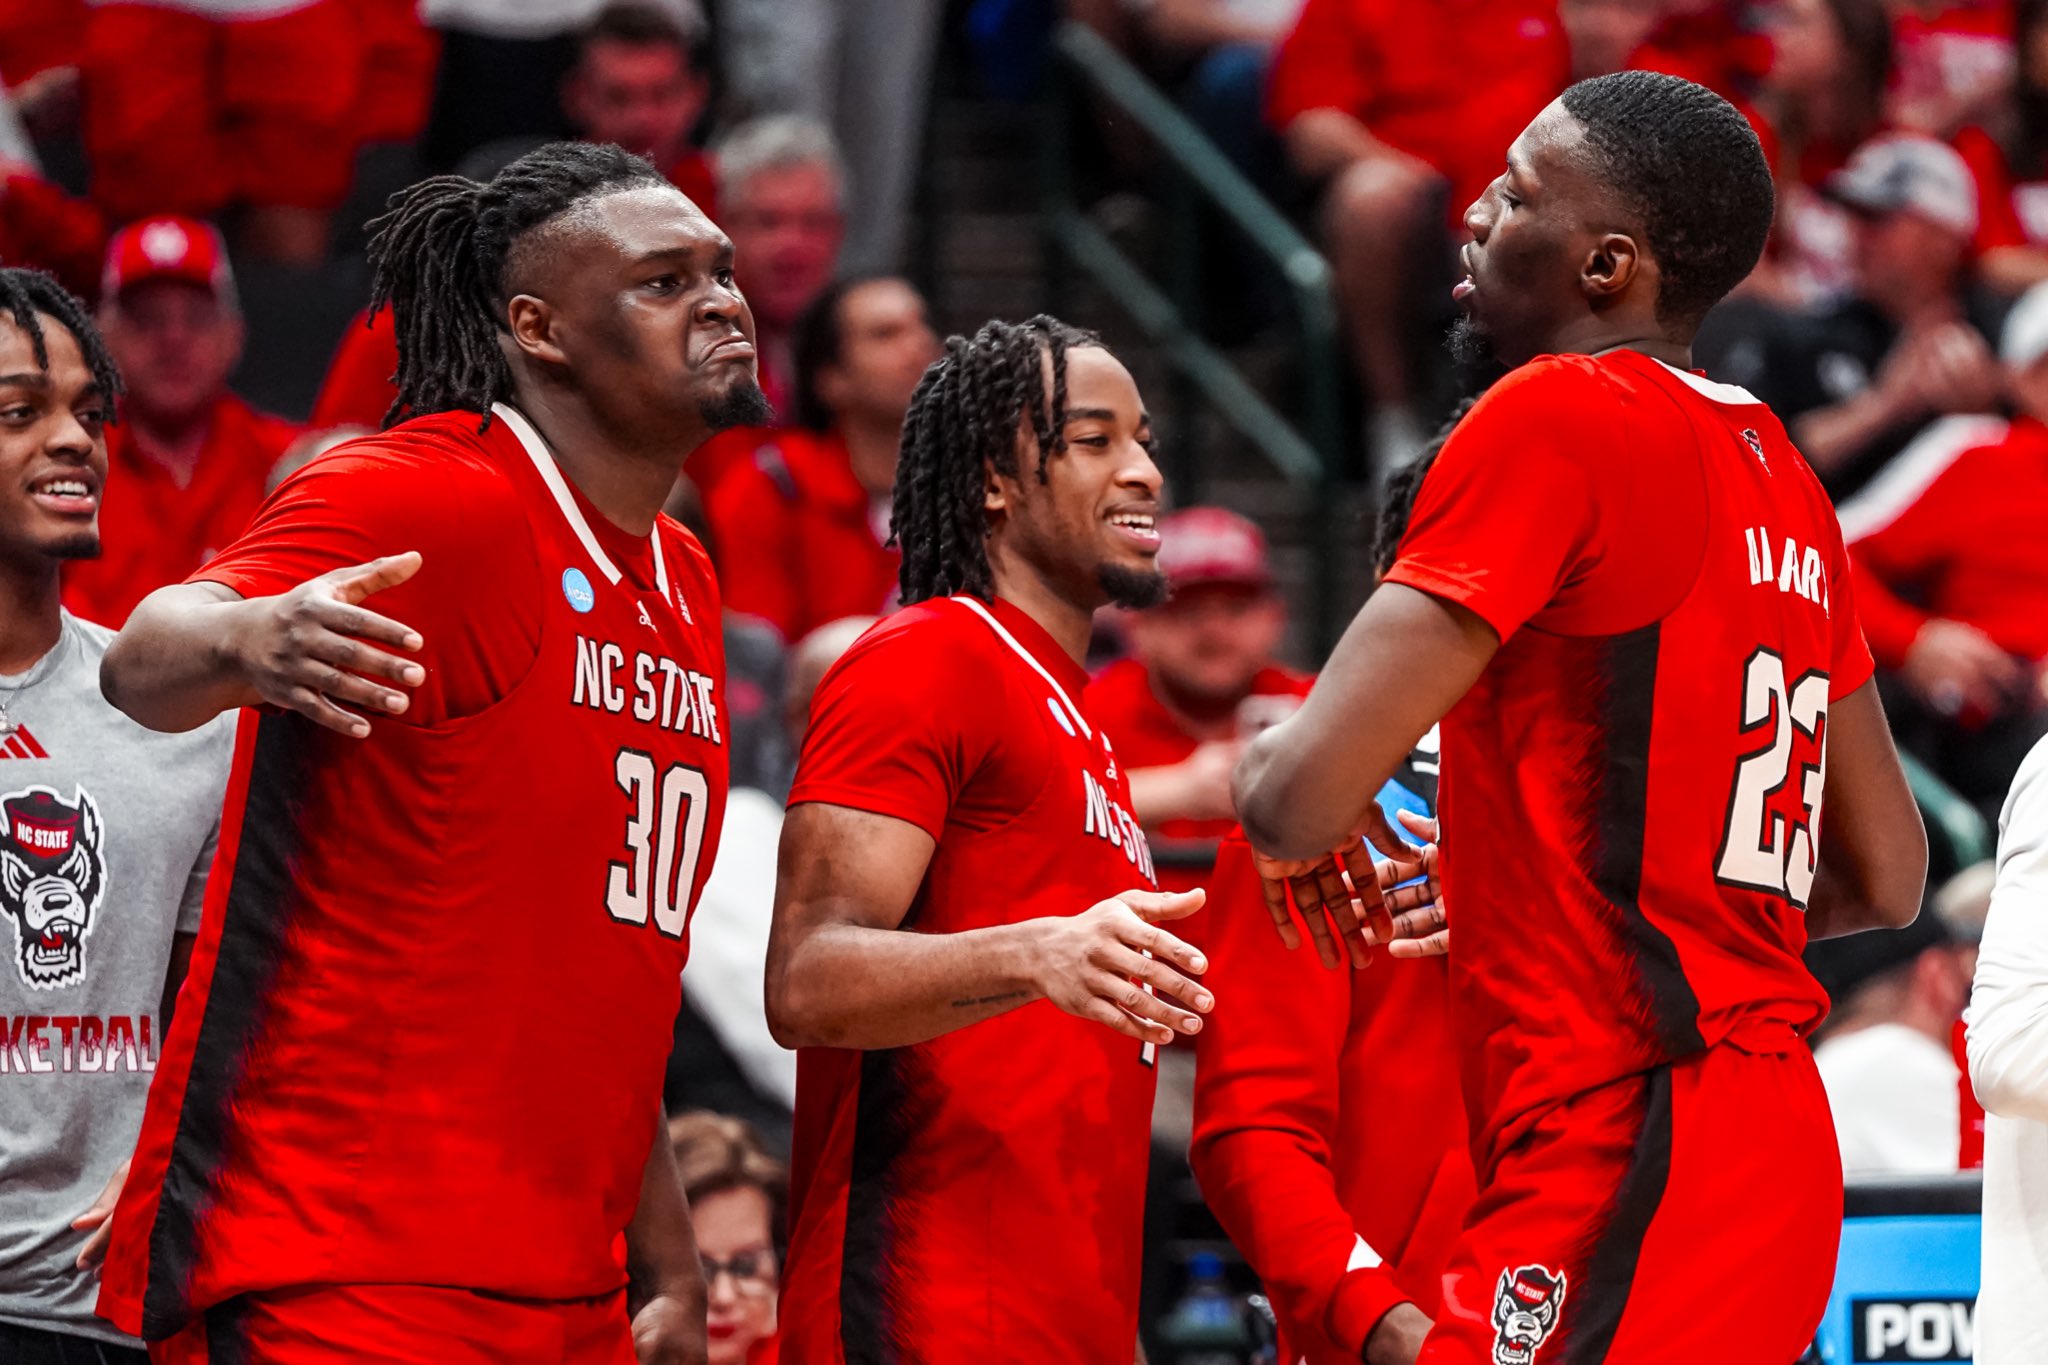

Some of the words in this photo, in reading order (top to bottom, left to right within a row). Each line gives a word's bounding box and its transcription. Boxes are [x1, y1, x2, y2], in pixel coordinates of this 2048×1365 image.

[571, 634, 625, 714] NC
[633, 650, 721, 746] STATE
[1082, 767, 1121, 847] NC
[1713, 643, 1830, 912] 23
[17, 821, 33, 844] NC
[34, 828, 68, 849] STATE
[604, 746, 709, 941] 30
